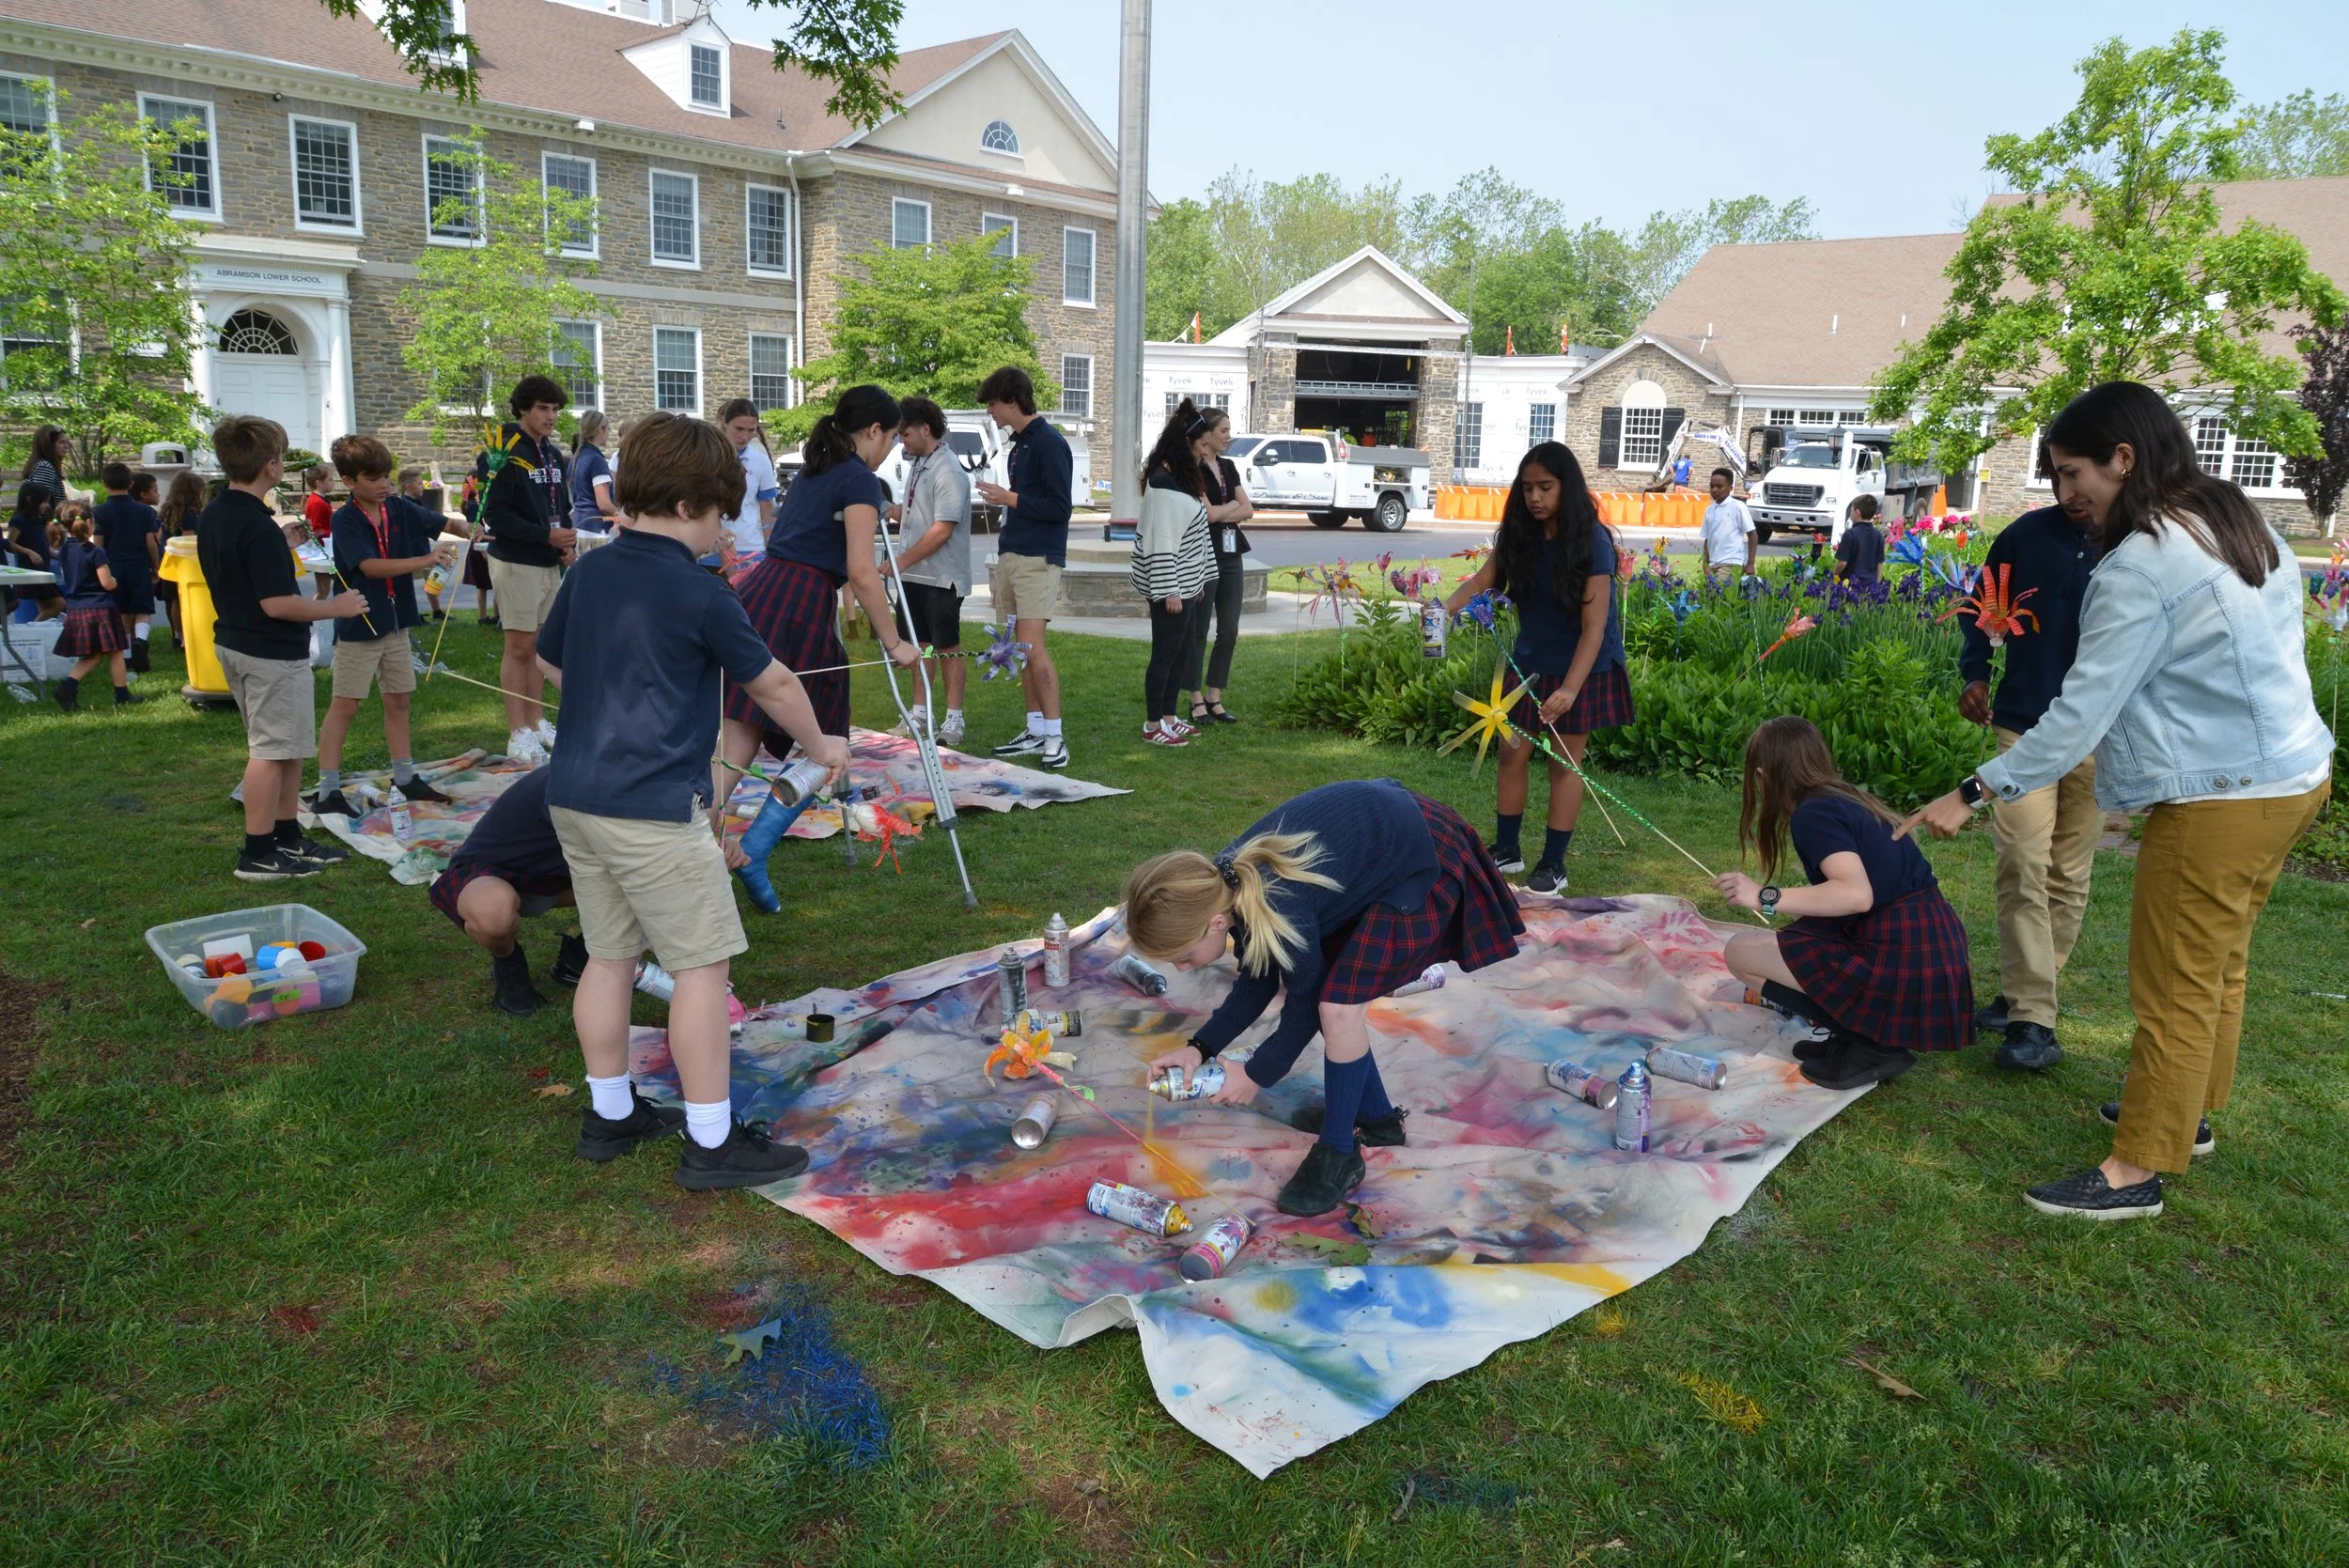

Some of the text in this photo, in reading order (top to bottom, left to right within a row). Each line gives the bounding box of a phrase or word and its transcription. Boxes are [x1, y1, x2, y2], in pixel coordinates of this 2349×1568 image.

[217, 269, 321, 284] ABRAMSON LOWER SCHOOL
[1169, 376, 1192, 386] Tyvek
[1210, 377, 1234, 387] Tyvek
[1526, 386, 1548, 396] Tyvek
[1724, 440, 1744, 464] EXCAVATING
